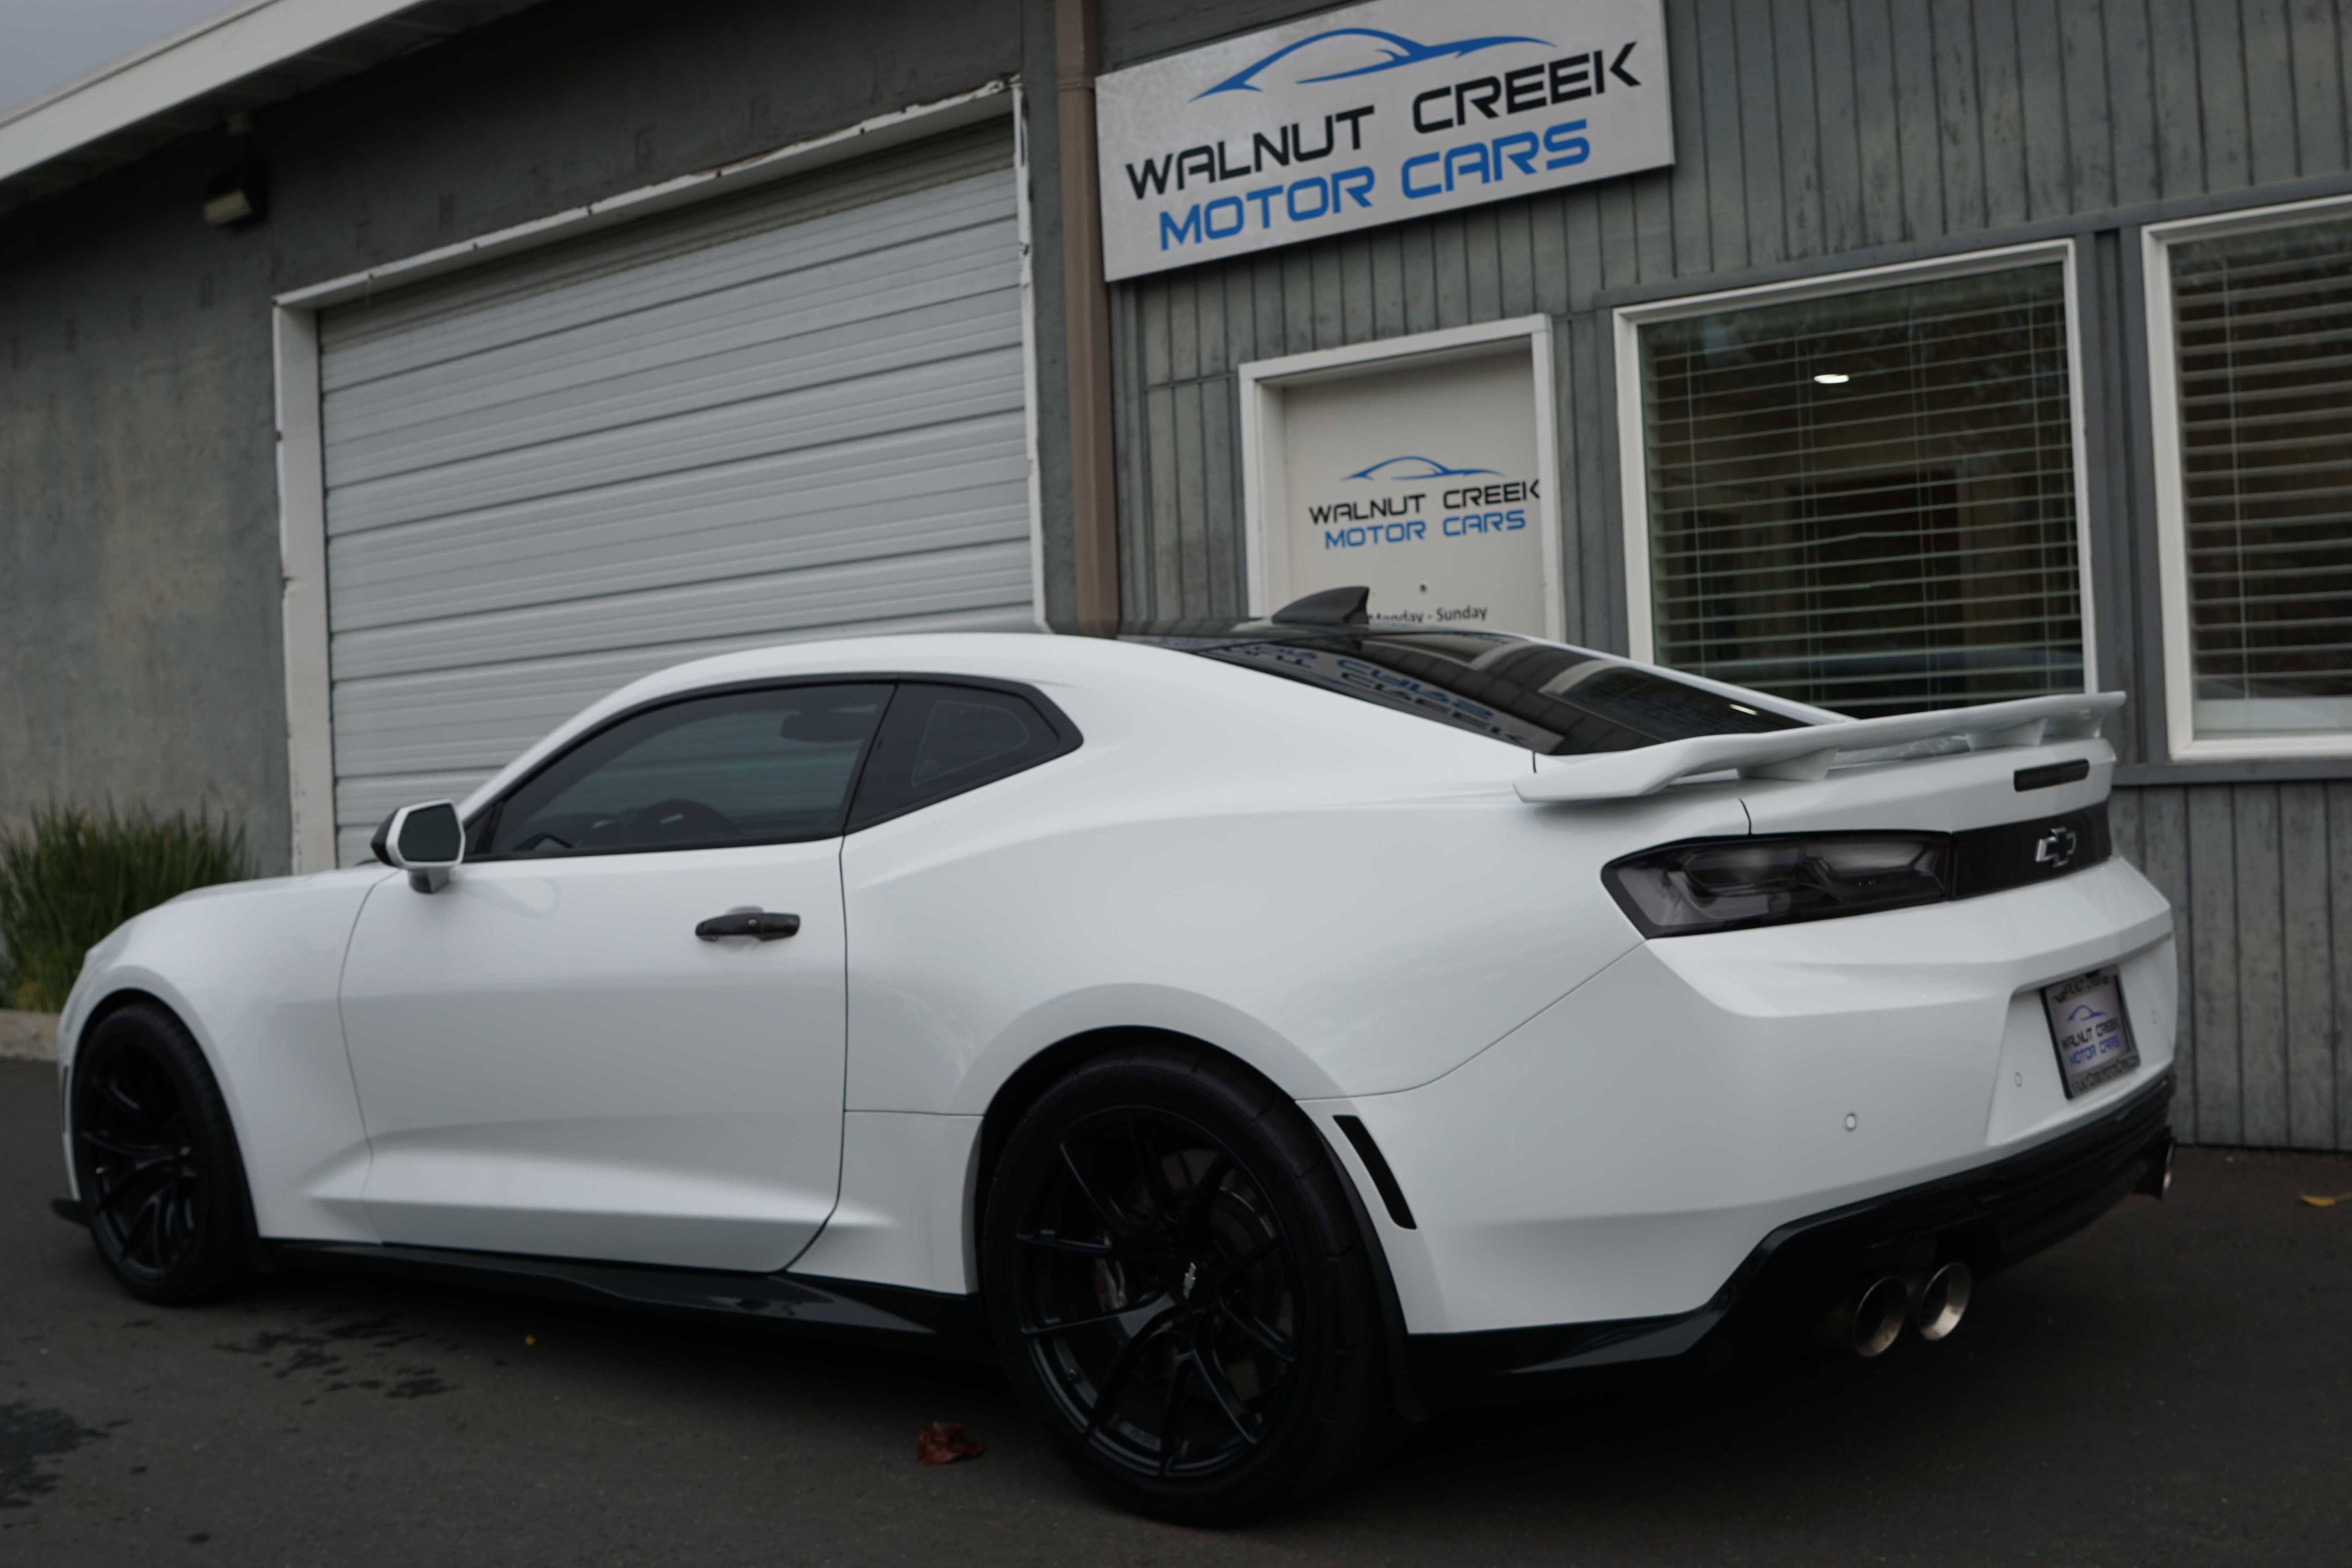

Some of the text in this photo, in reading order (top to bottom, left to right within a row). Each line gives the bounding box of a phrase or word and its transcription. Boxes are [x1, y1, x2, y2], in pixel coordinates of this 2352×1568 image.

[1125, 41, 1642, 200] WALNUT CREEK
[1159, 118, 1591, 252] MOTOR CARS
[1309, 479, 1540, 525] WALNUT CREEK
[1324, 509, 1526, 550] MOTOR CARS
[1436, 605, 1488, 621] Sunday
[2068, 1044, 2097, 1064] MOTOR
